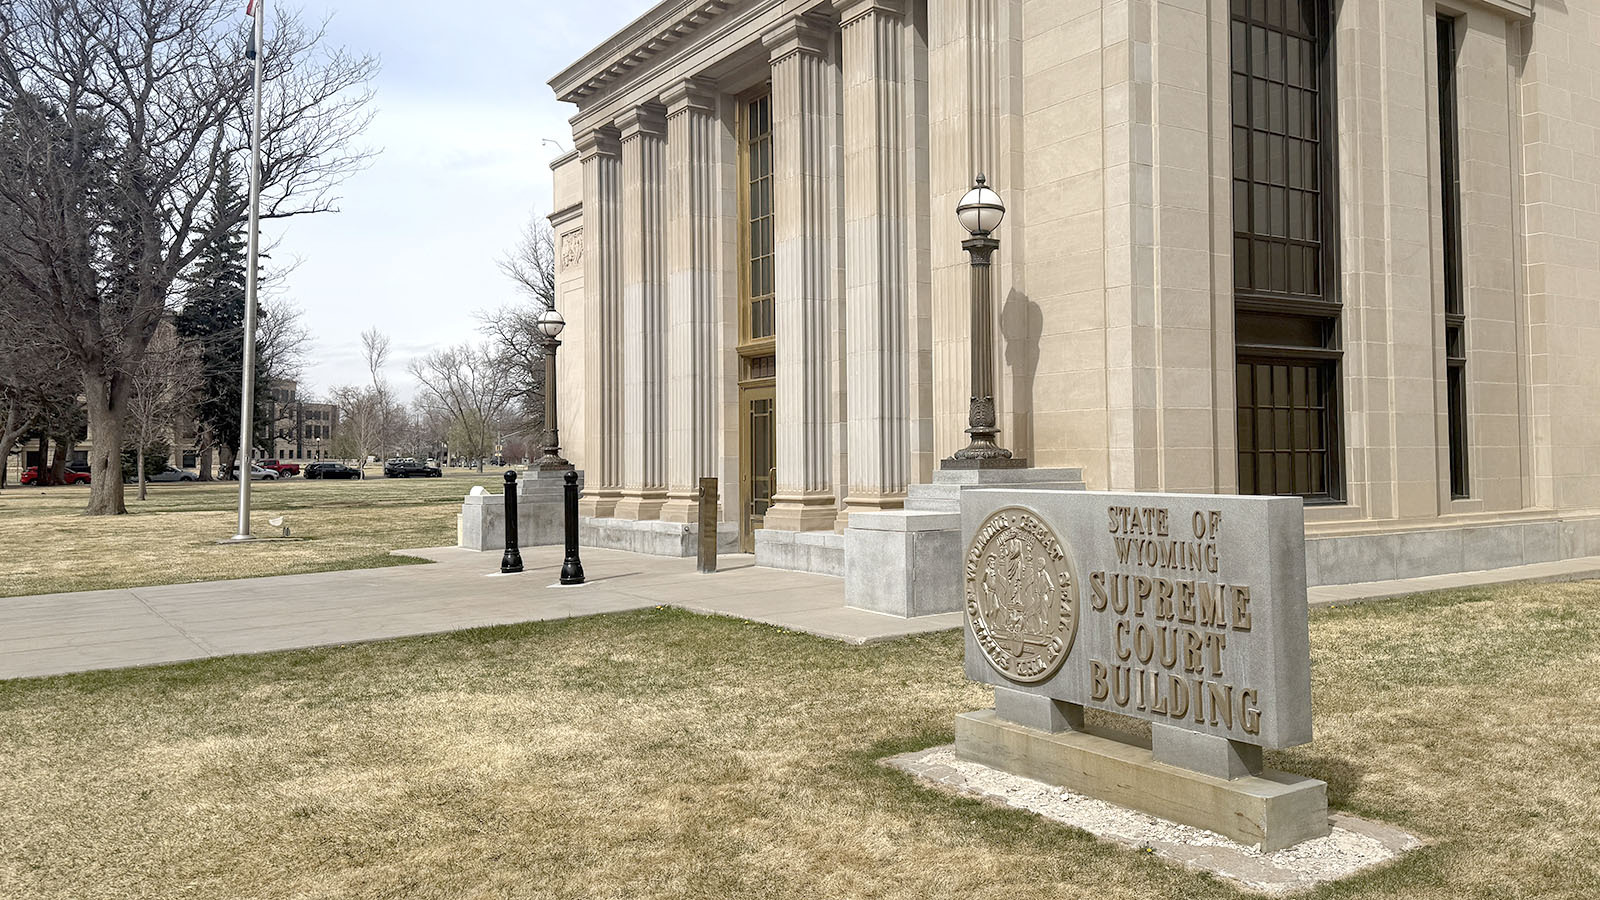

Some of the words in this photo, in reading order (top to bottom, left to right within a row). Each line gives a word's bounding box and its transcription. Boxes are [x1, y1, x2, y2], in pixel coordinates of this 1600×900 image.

[967, 514, 1008, 583] WYOMING
[1019, 515, 1064, 561] GREAT
[1108, 506, 1168, 536] STATE
[1192, 510, 1221, 539] OF
[1114, 538, 1219, 573] WYOMING
[1058, 572, 1072, 631] SEAL
[1090, 572, 1251, 632] SUPREME
[1114, 619, 1226, 677] COURT
[1090, 659, 1262, 735] BUILDING
